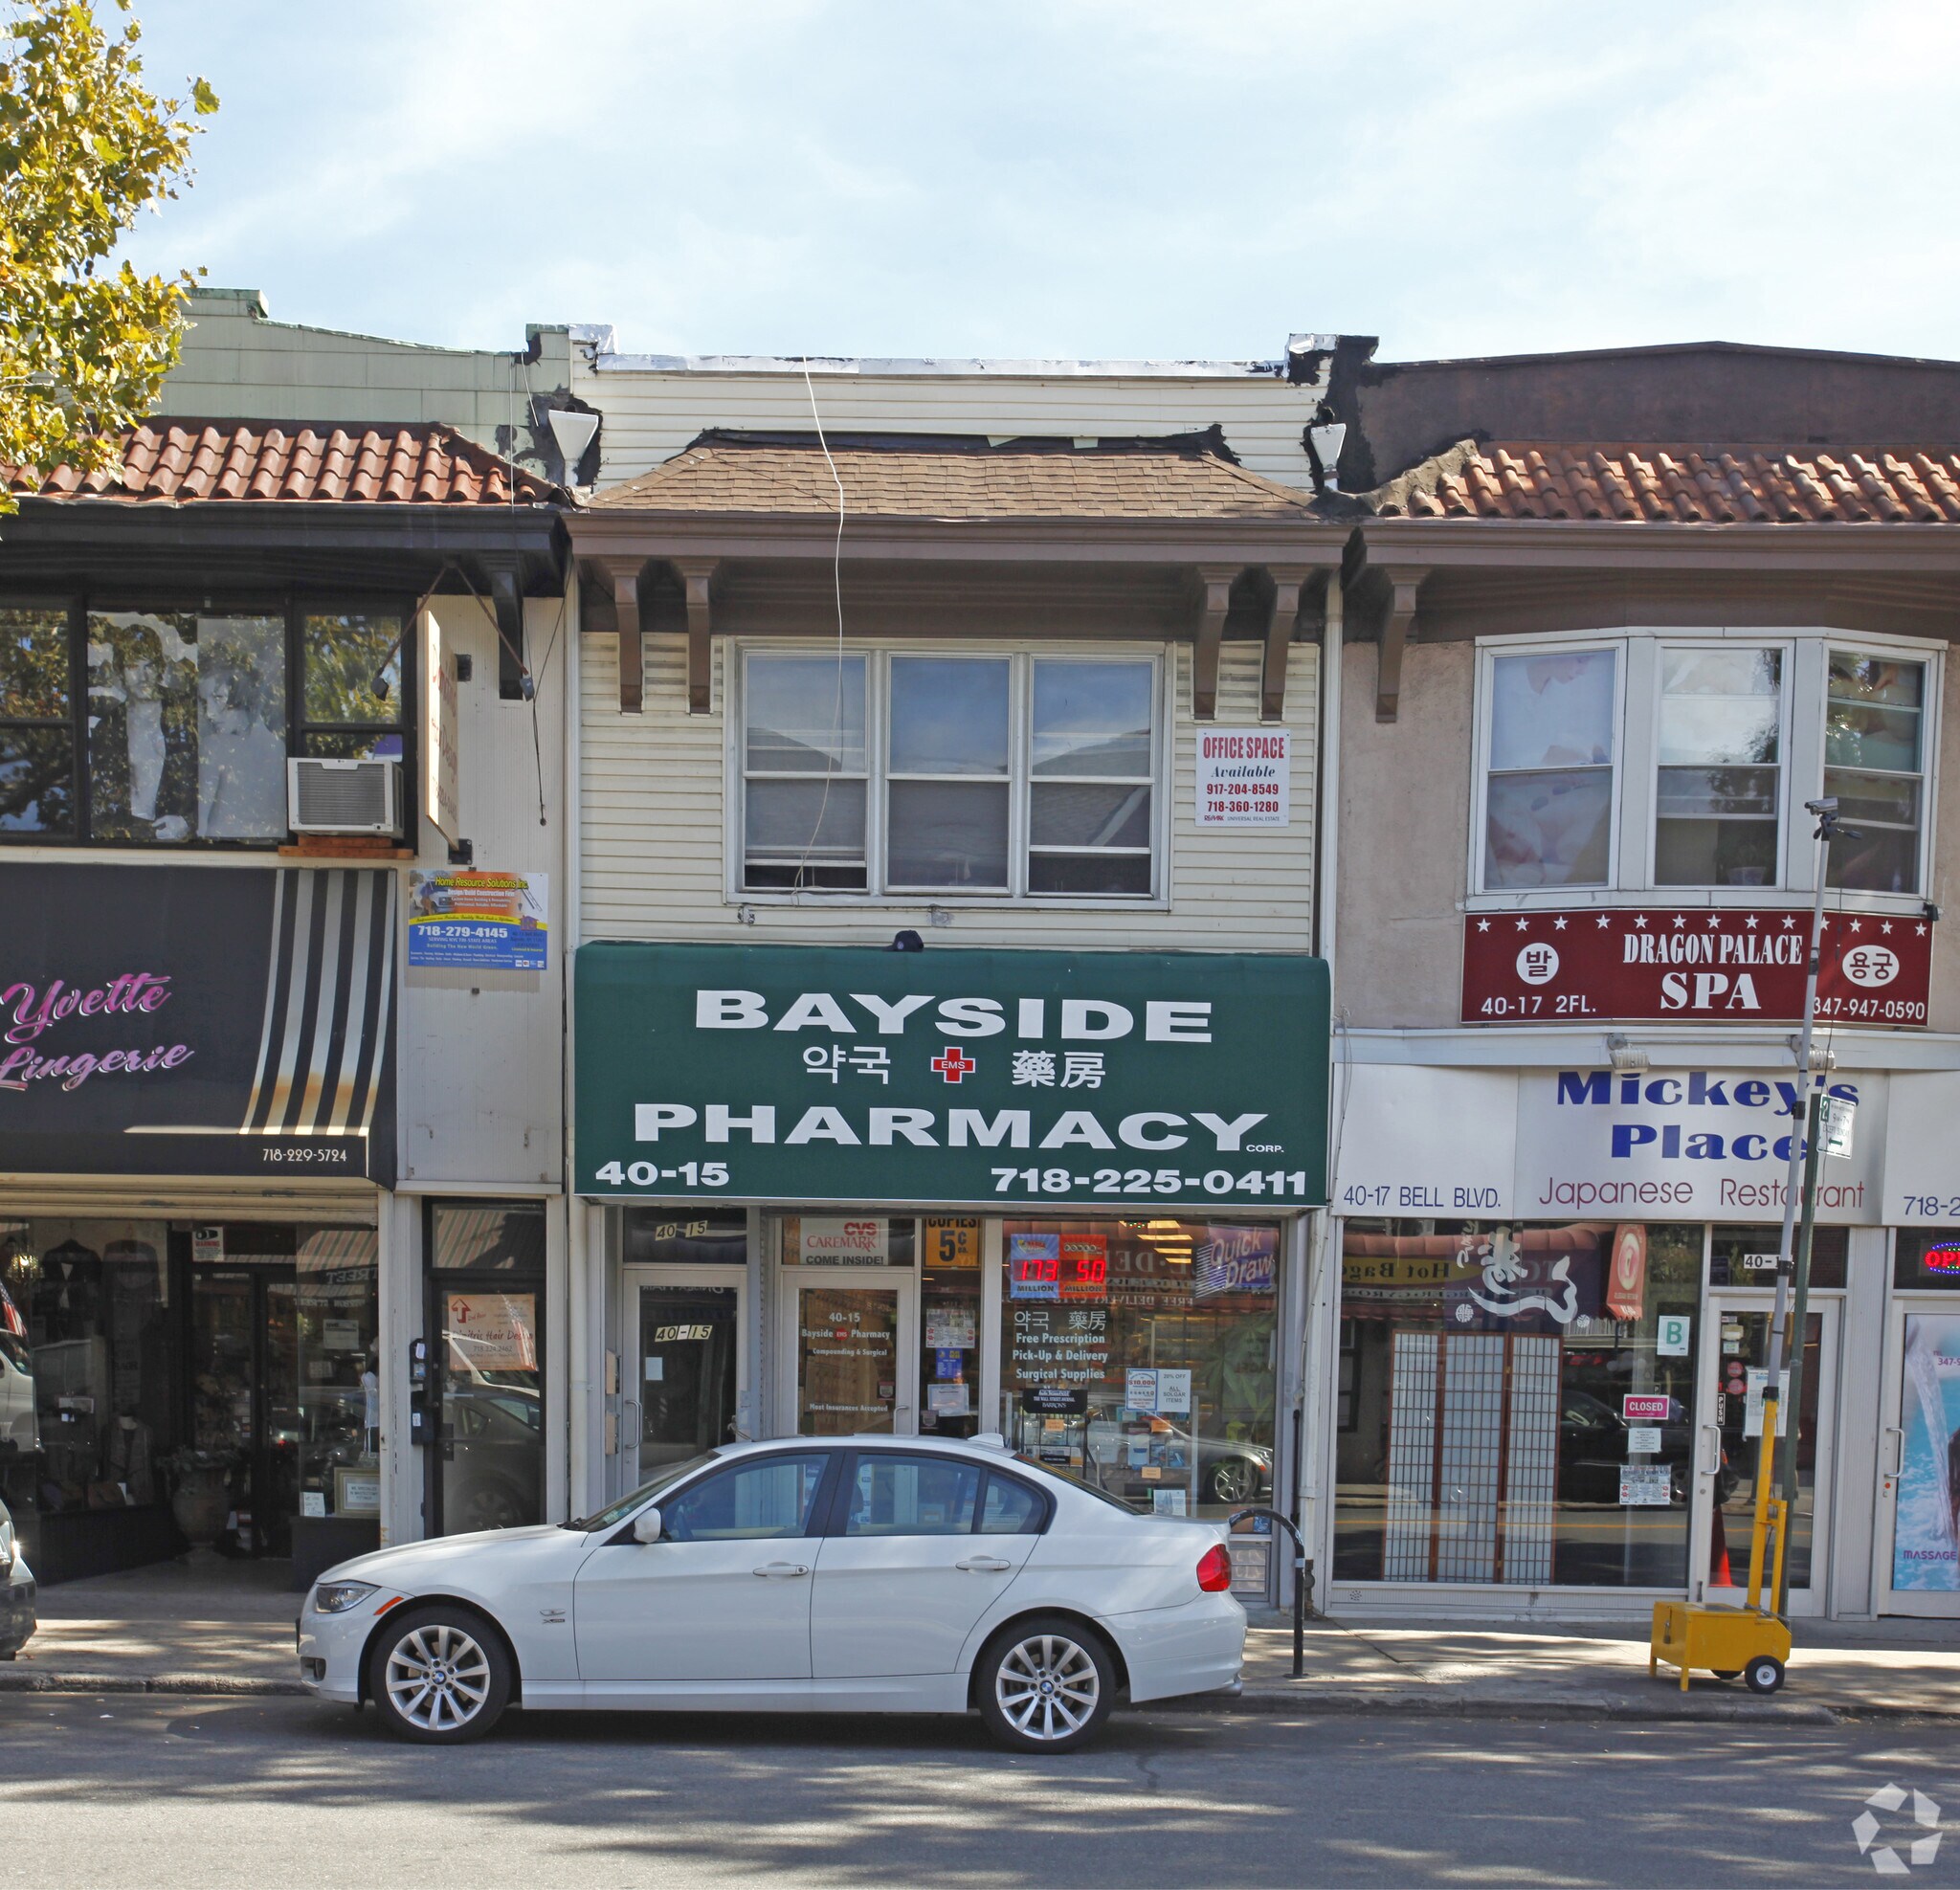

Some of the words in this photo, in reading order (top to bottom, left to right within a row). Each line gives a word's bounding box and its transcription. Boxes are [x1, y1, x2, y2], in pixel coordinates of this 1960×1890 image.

[1203, 737, 1243, 759] OFFICE
[1246, 737, 1284, 759] SPACE
[1211, 766, 1275, 777] Available
[1207, 784, 1279, 794] 917-204-8549
[1208, 801, 1279, 812] 718-360-1280
[435, 877, 454, 886] Home
[456, 878, 485, 887] Resource
[487, 878, 516, 888] Solutions
[517, 879, 529, 889] Inc.
[417, 925, 508, 939] 718-279-4145
[1623, 934, 1715, 965] DRAGON
[1719, 934, 1803, 966] PALACE
[1526, 950, 1552, 978] 발
[1849, 951, 1893, 981] 용궁
[1660, 972, 1762, 1011] SPA
[1, 972, 172, 1044] Yvette
[1481, 995, 1543, 1015] 40-17
[1555, 995, 1597, 1013] 2FL.
[1813, 997, 1926, 1020] 347-947-0590
[696, 989, 1213, 1043] BAYSIDE
[0, 1043, 195, 1093] Lingerie
[802, 1045, 891, 1086] 약국
[940, 1059, 967, 1071] EMS
[1011, 1050, 1105, 1089] 藥房
[1557, 1071, 1860, 1116] Mickey's
[634, 1103, 1269, 1151] PHARMACY
[1245, 1144, 1285, 1153] CORP.
[1612, 1124, 1808, 1162] Place
[262, 1148, 348, 1164] 718-229-5724
[595, 1162, 730, 1187] 40-15
[991, 1167, 1306, 1196] 718-225-0411
[1344, 1186, 1391, 1206] 40-17
[1399, 1187, 1444, 1207] BELL
[1454, 1188, 1501, 1209] BLVD.
[1539, 1177, 1693, 1210] Japanese
[1904, 1194, 1960, 1216] 718-2
[657, 1225, 676, 1238] 40
[688, 1222, 706, 1235] 15
[844, 1222, 877, 1235] CVS
[807, 1235, 876, 1252] CAREMARK
[939, 1231, 956, 1262] 5
[1211, 1227, 1261, 1267] Quick
[806, 1256, 839, 1264] COME
[843, 1256, 883, 1265] INSIDE!
[1021, 1259, 1058, 1281] 173
[1077, 1259, 1106, 1283] 50
[1224, 1255, 1274, 1290] Draw
[829, 1312, 860, 1323] 40-15
[1014, 1311, 1049, 1331] 약국
[1069, 1311, 1106, 1330] 藥房
[486, 1330, 503, 1341] Hair
[657, 1326, 710, 1340] 40-15
[802, 1329, 833, 1339] Bayside
[851, 1330, 890, 1340] Pharmacy
[1016, 1333, 1038, 1343] Free
[1042, 1333, 1104, 1345] Prescription
[1666, 1322, 1682, 1345] B
[1013, 1350, 1052, 1363] Pick-Up
[1056, 1350, 1062, 1360] &
[1066, 1350, 1107, 1363] Delivery
[1016, 1368, 1057, 1381] Surgical
[1060, 1368, 1104, 1381] Supplies
[1629, 1402, 1663, 1412] CLOSED
[1904, 1550, 1957, 1560] MASSAGE
